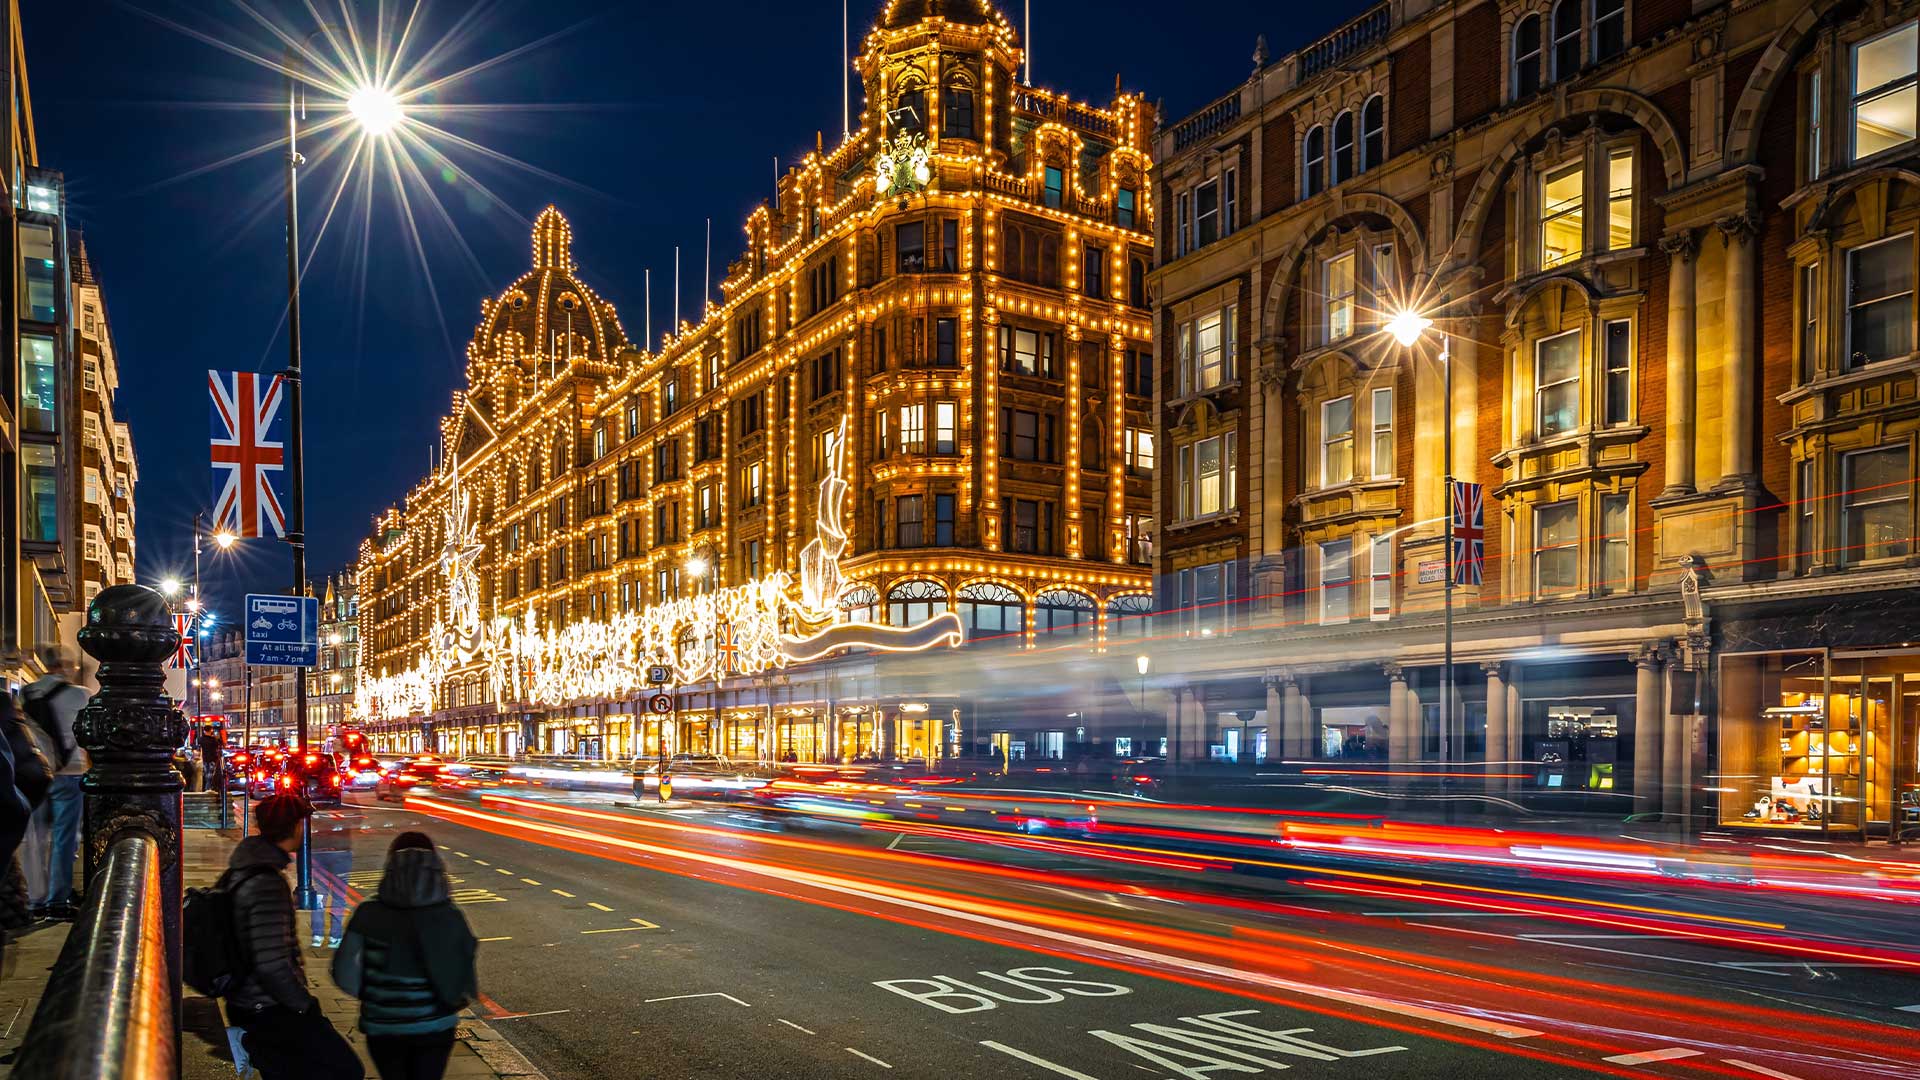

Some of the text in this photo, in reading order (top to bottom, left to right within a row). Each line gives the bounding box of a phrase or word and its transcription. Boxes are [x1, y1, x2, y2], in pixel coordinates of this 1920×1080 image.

[252, 631, 268, 639] taxi
[872, 967, 1133, 1014] BUS
[1088, 1010, 1408, 1080] ANE
